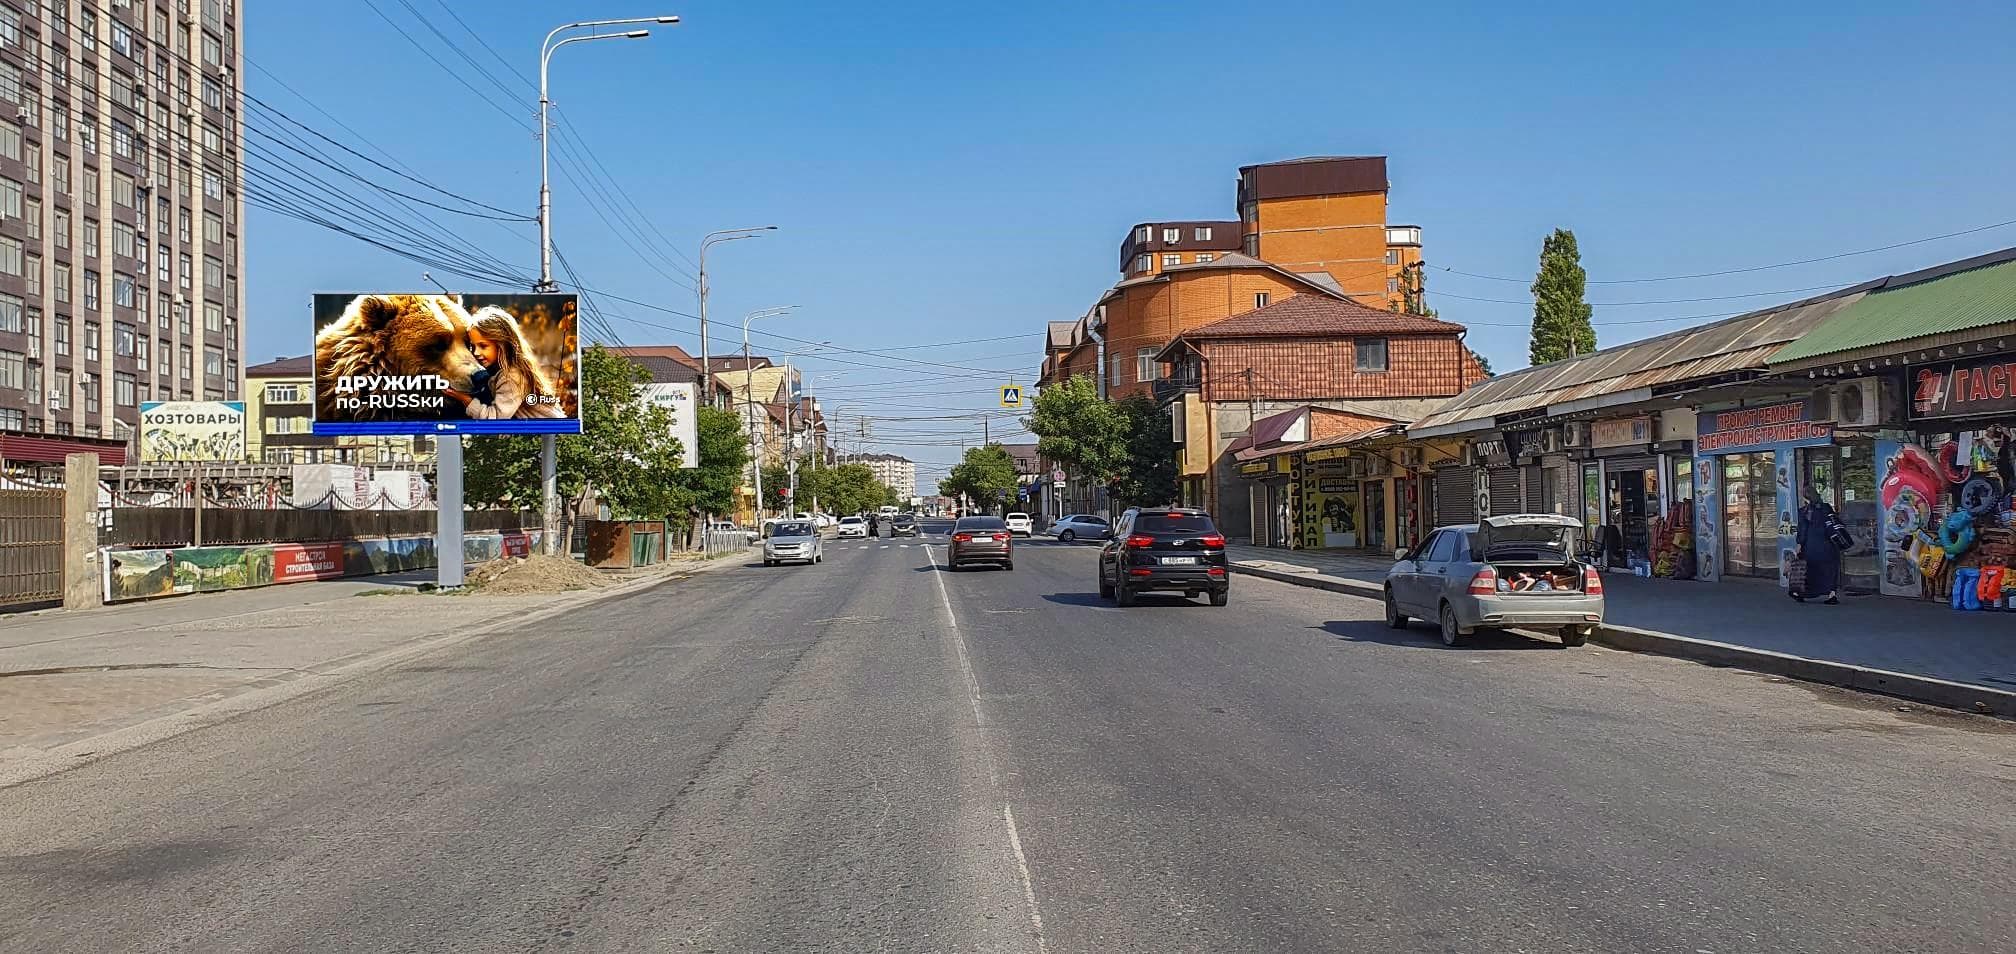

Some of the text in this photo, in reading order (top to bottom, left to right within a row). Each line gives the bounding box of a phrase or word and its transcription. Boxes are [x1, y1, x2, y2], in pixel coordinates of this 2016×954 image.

[334, 374, 450, 394] ДРУЖИТЬ
[336, 394, 444, 409] по-RUSSки
[539, 395, 561, 405] Russ
[144, 414, 241, 424] ХОЗТОВАРЫ
[1716, 402, 1803, 431] ПРОКАТ РЕМОНТ
